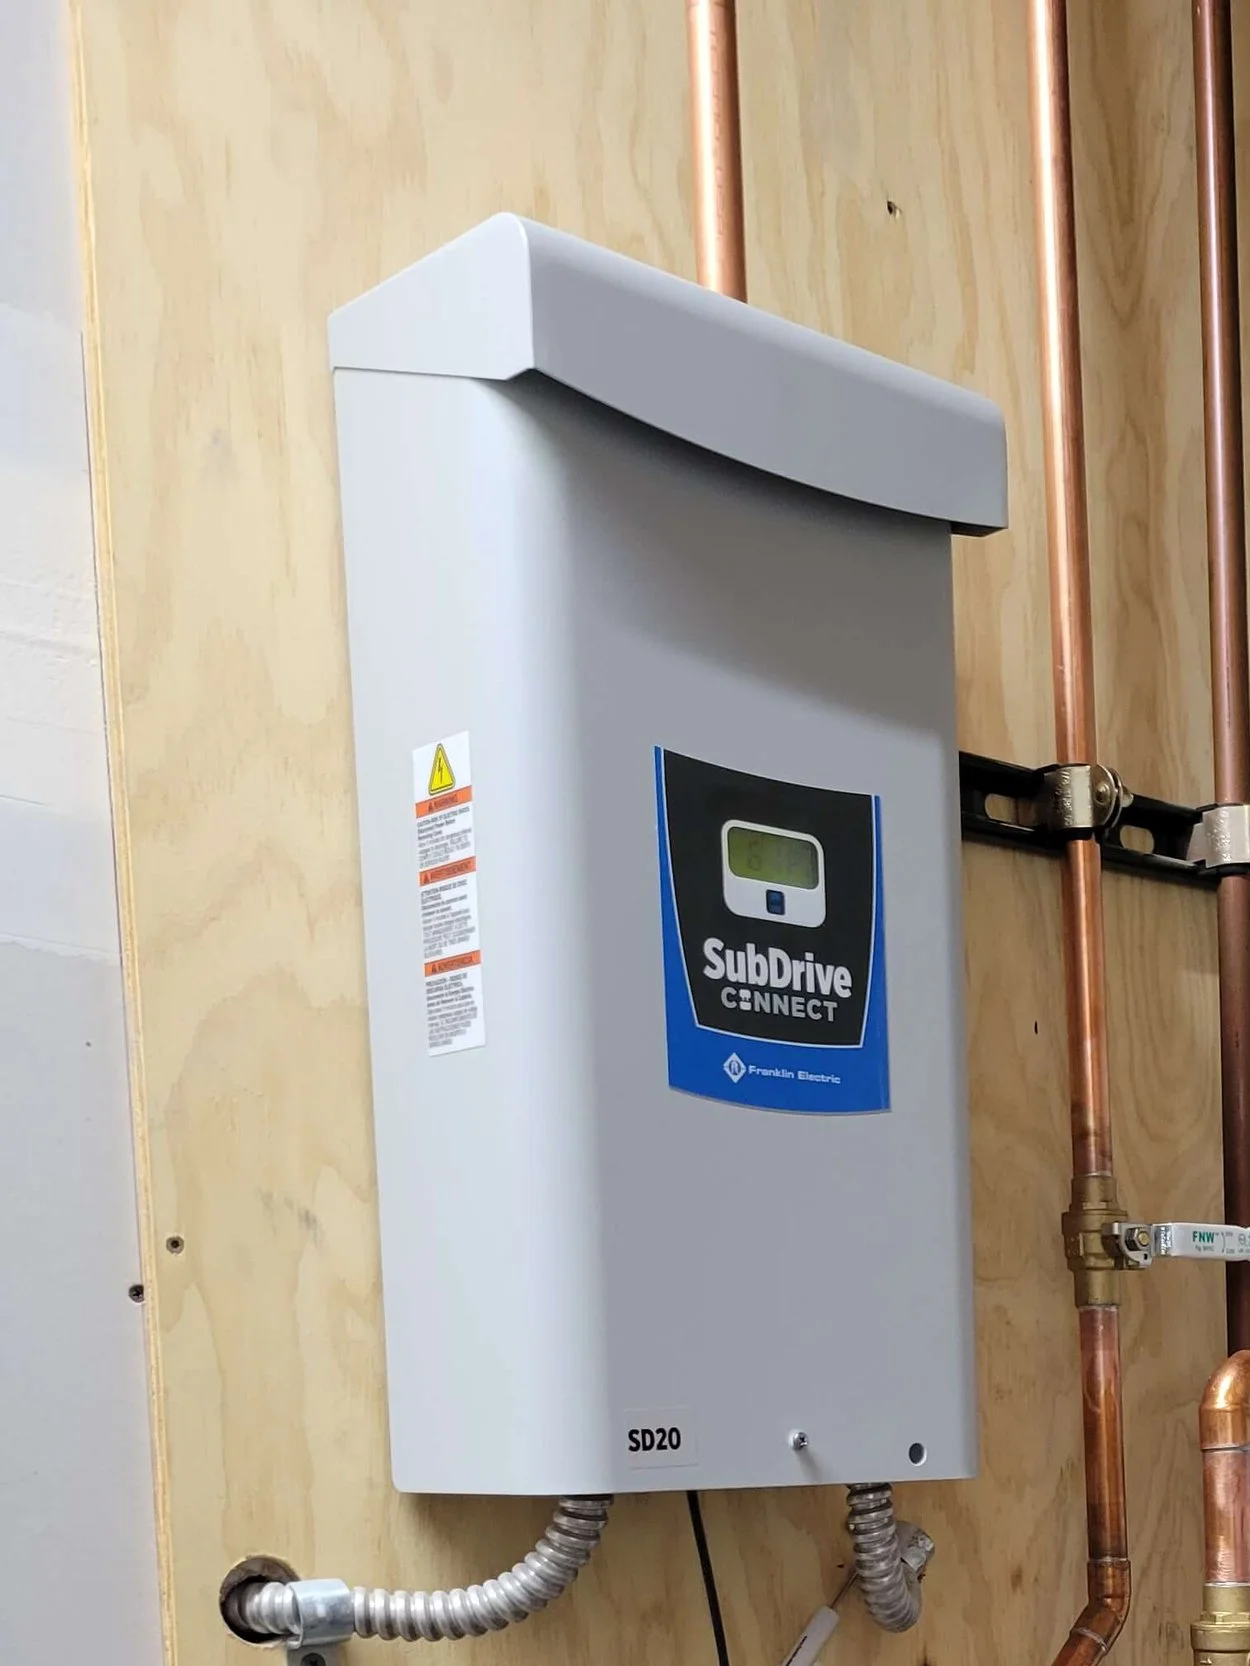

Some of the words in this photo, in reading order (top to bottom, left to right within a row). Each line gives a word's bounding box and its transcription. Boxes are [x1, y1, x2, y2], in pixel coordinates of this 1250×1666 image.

[703, 937, 852, 998] SubDrive
[748, 1065, 794, 1080] Franklin
[798, 1070, 841, 1085] Electric
[1192, 1231, 1215, 1243] FNW
[628, 1427, 681, 1451] SD20
